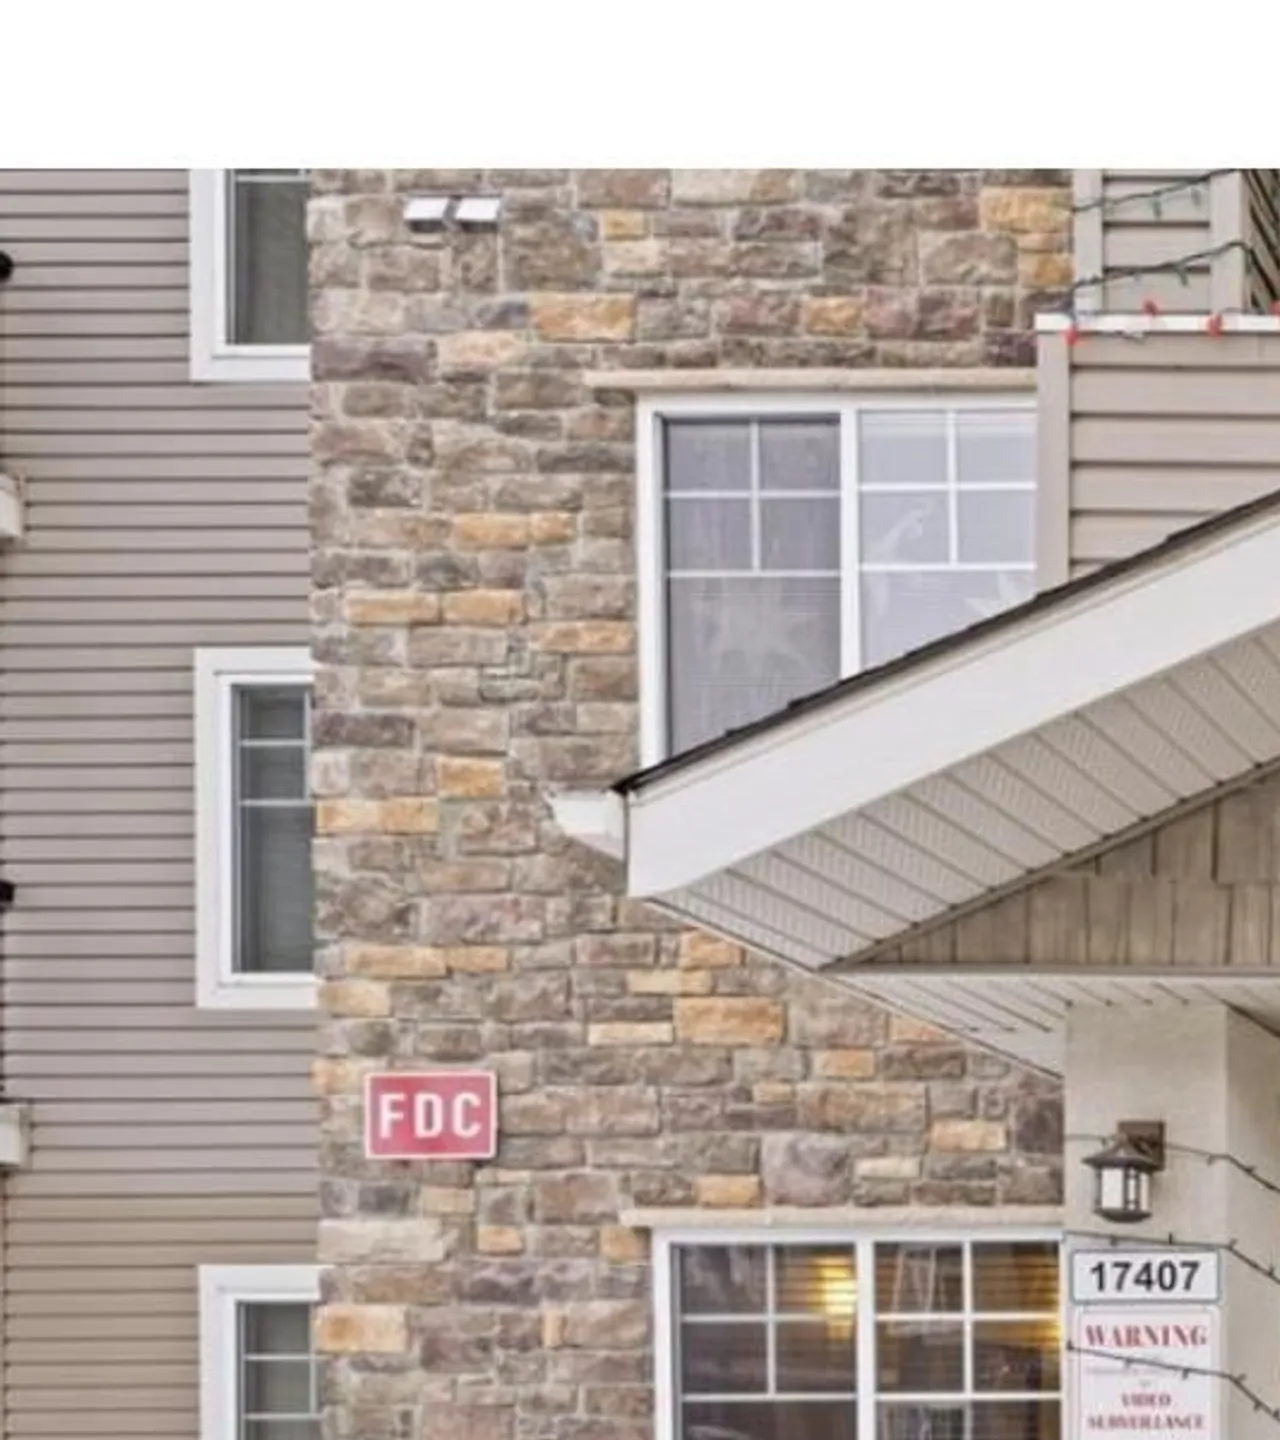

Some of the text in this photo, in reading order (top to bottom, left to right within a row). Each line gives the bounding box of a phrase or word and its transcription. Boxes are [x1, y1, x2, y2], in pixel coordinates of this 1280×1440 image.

[379, 1091, 482, 1140] FDC
[1091, 1260, 1199, 1291] 17407
[1086, 1325, 1206, 1347] WARNING
[1120, 1392, 1172, 1408] VIDEO
